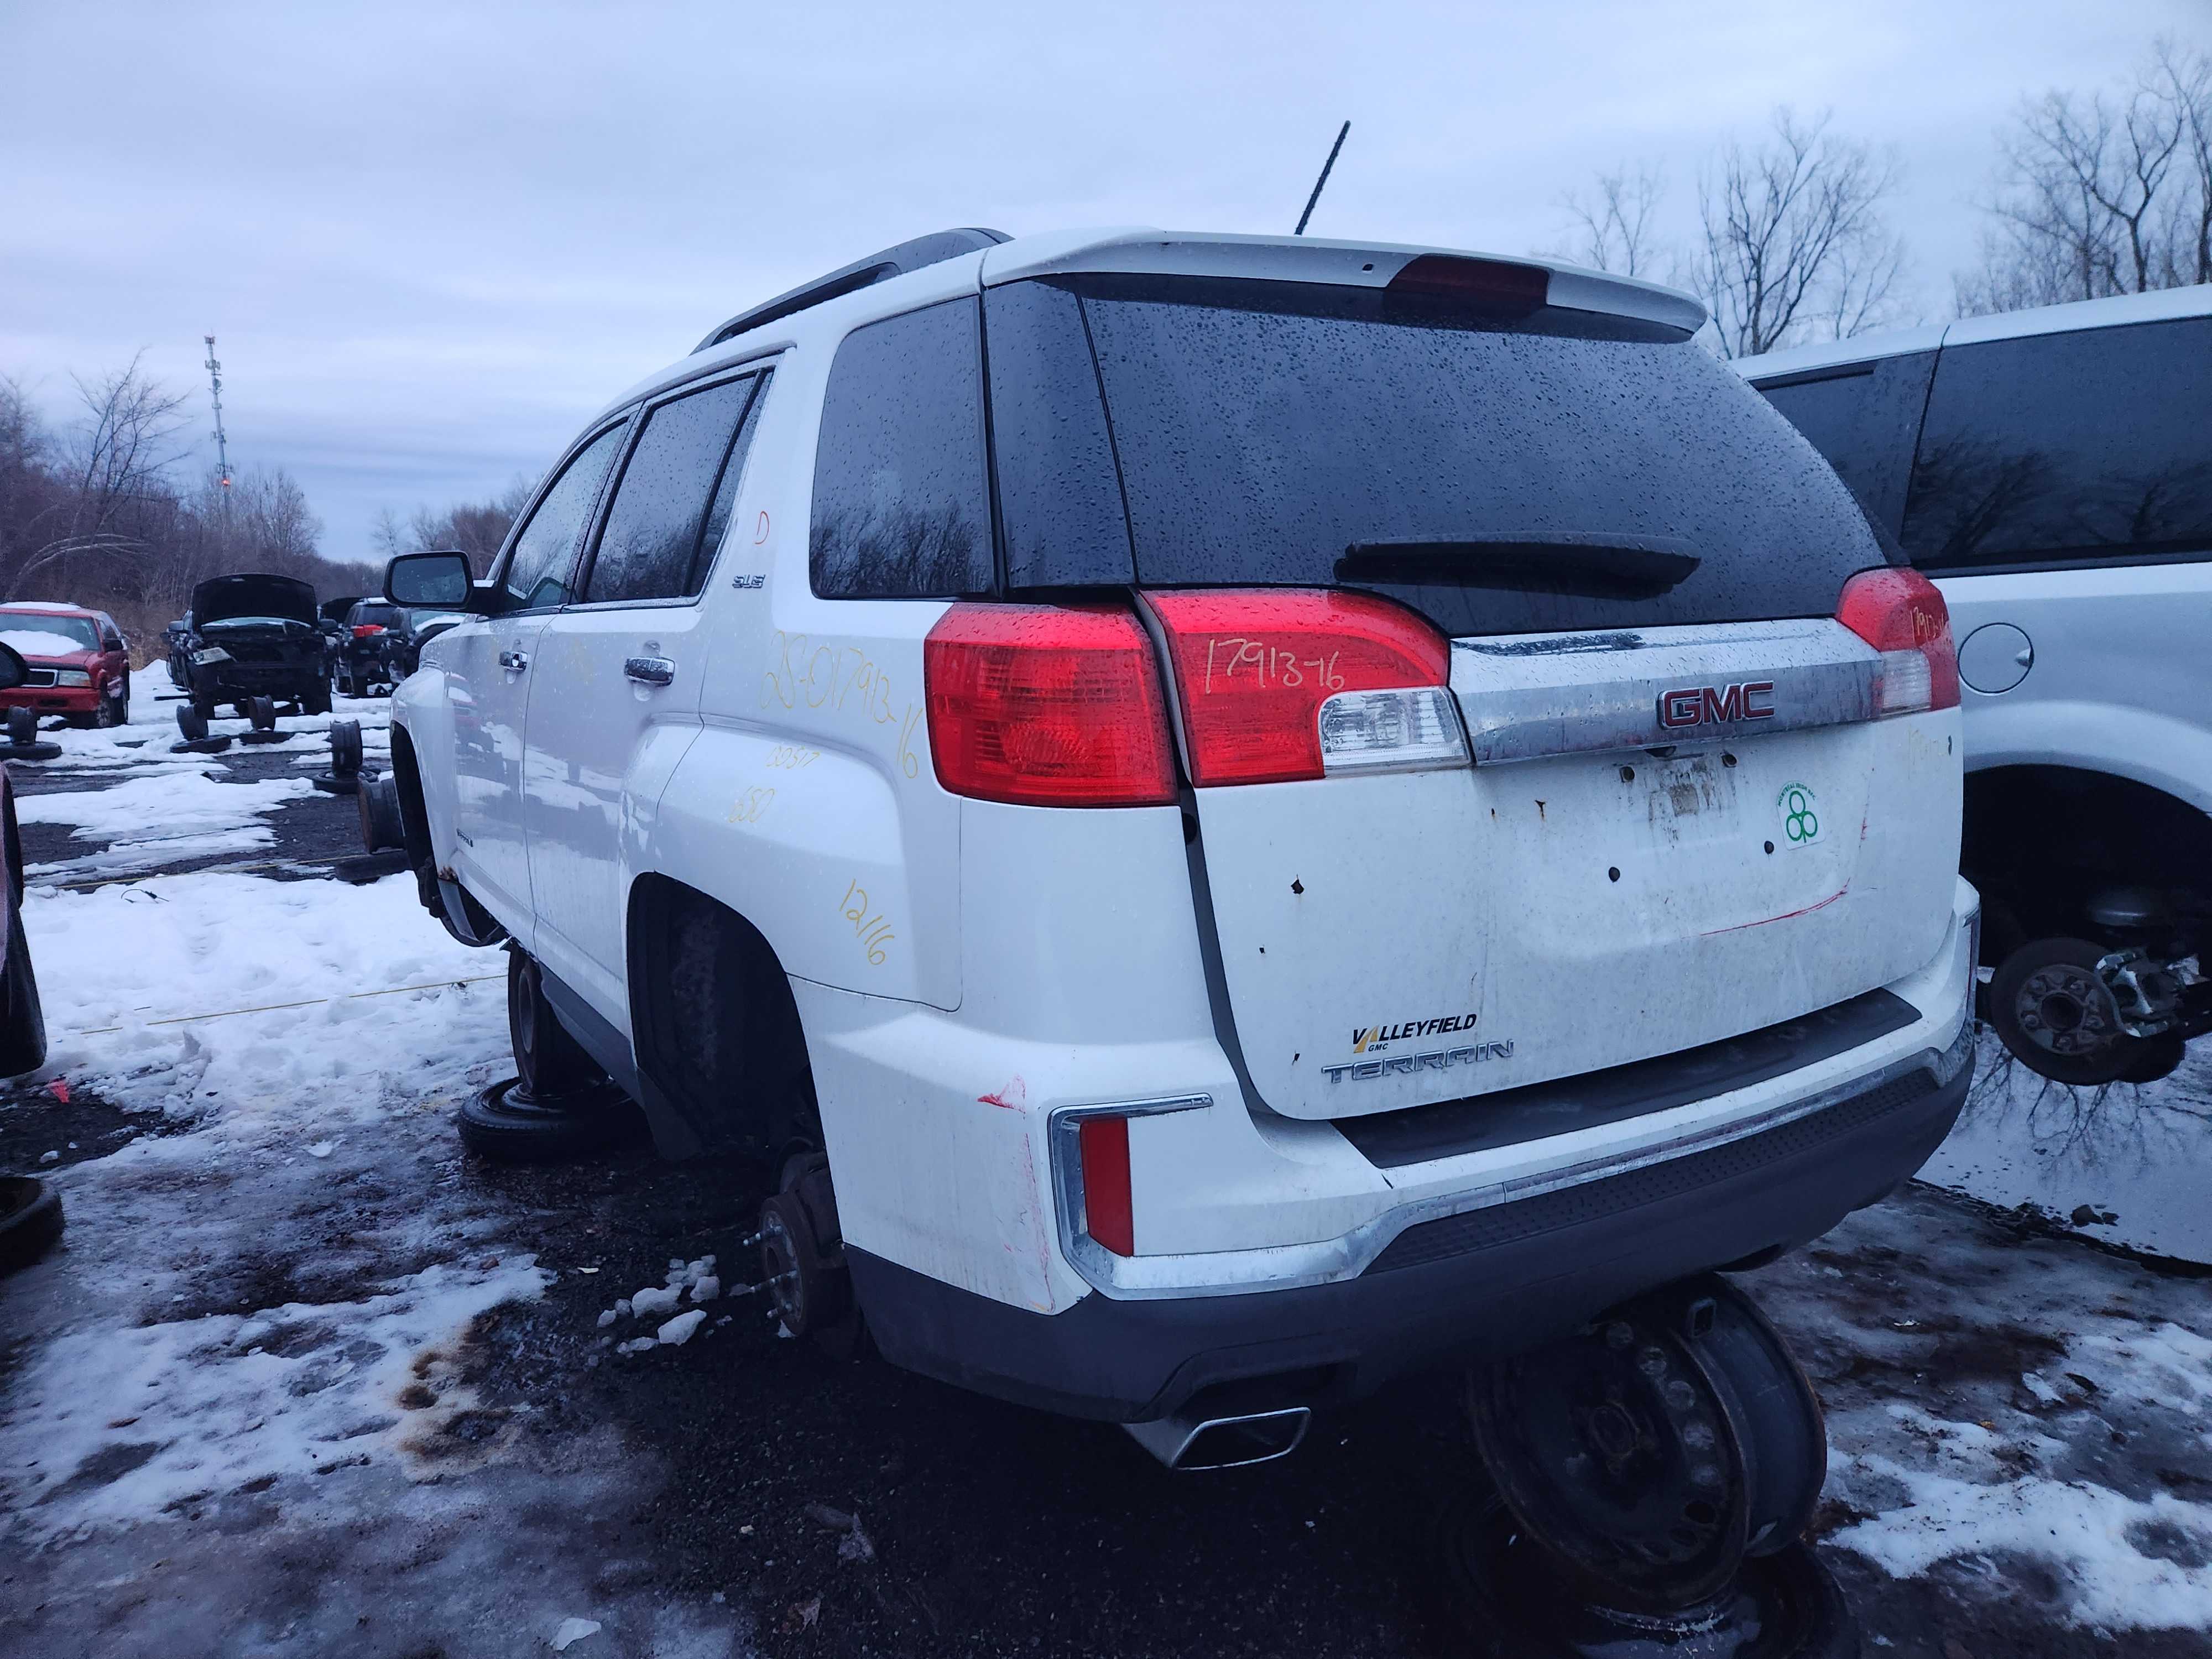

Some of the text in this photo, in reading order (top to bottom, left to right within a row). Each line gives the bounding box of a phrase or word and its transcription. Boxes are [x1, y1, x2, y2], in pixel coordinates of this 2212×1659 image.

[1205, 638, 1345, 694] 17913-16
[1656, 680, 1775, 730] GMC
[1353, 1013, 1478, 1053] VALLEYFIELD
[1368, 1042, 1389, 1052] GMC
[1321, 1039, 1515, 1084] TERRAIN
